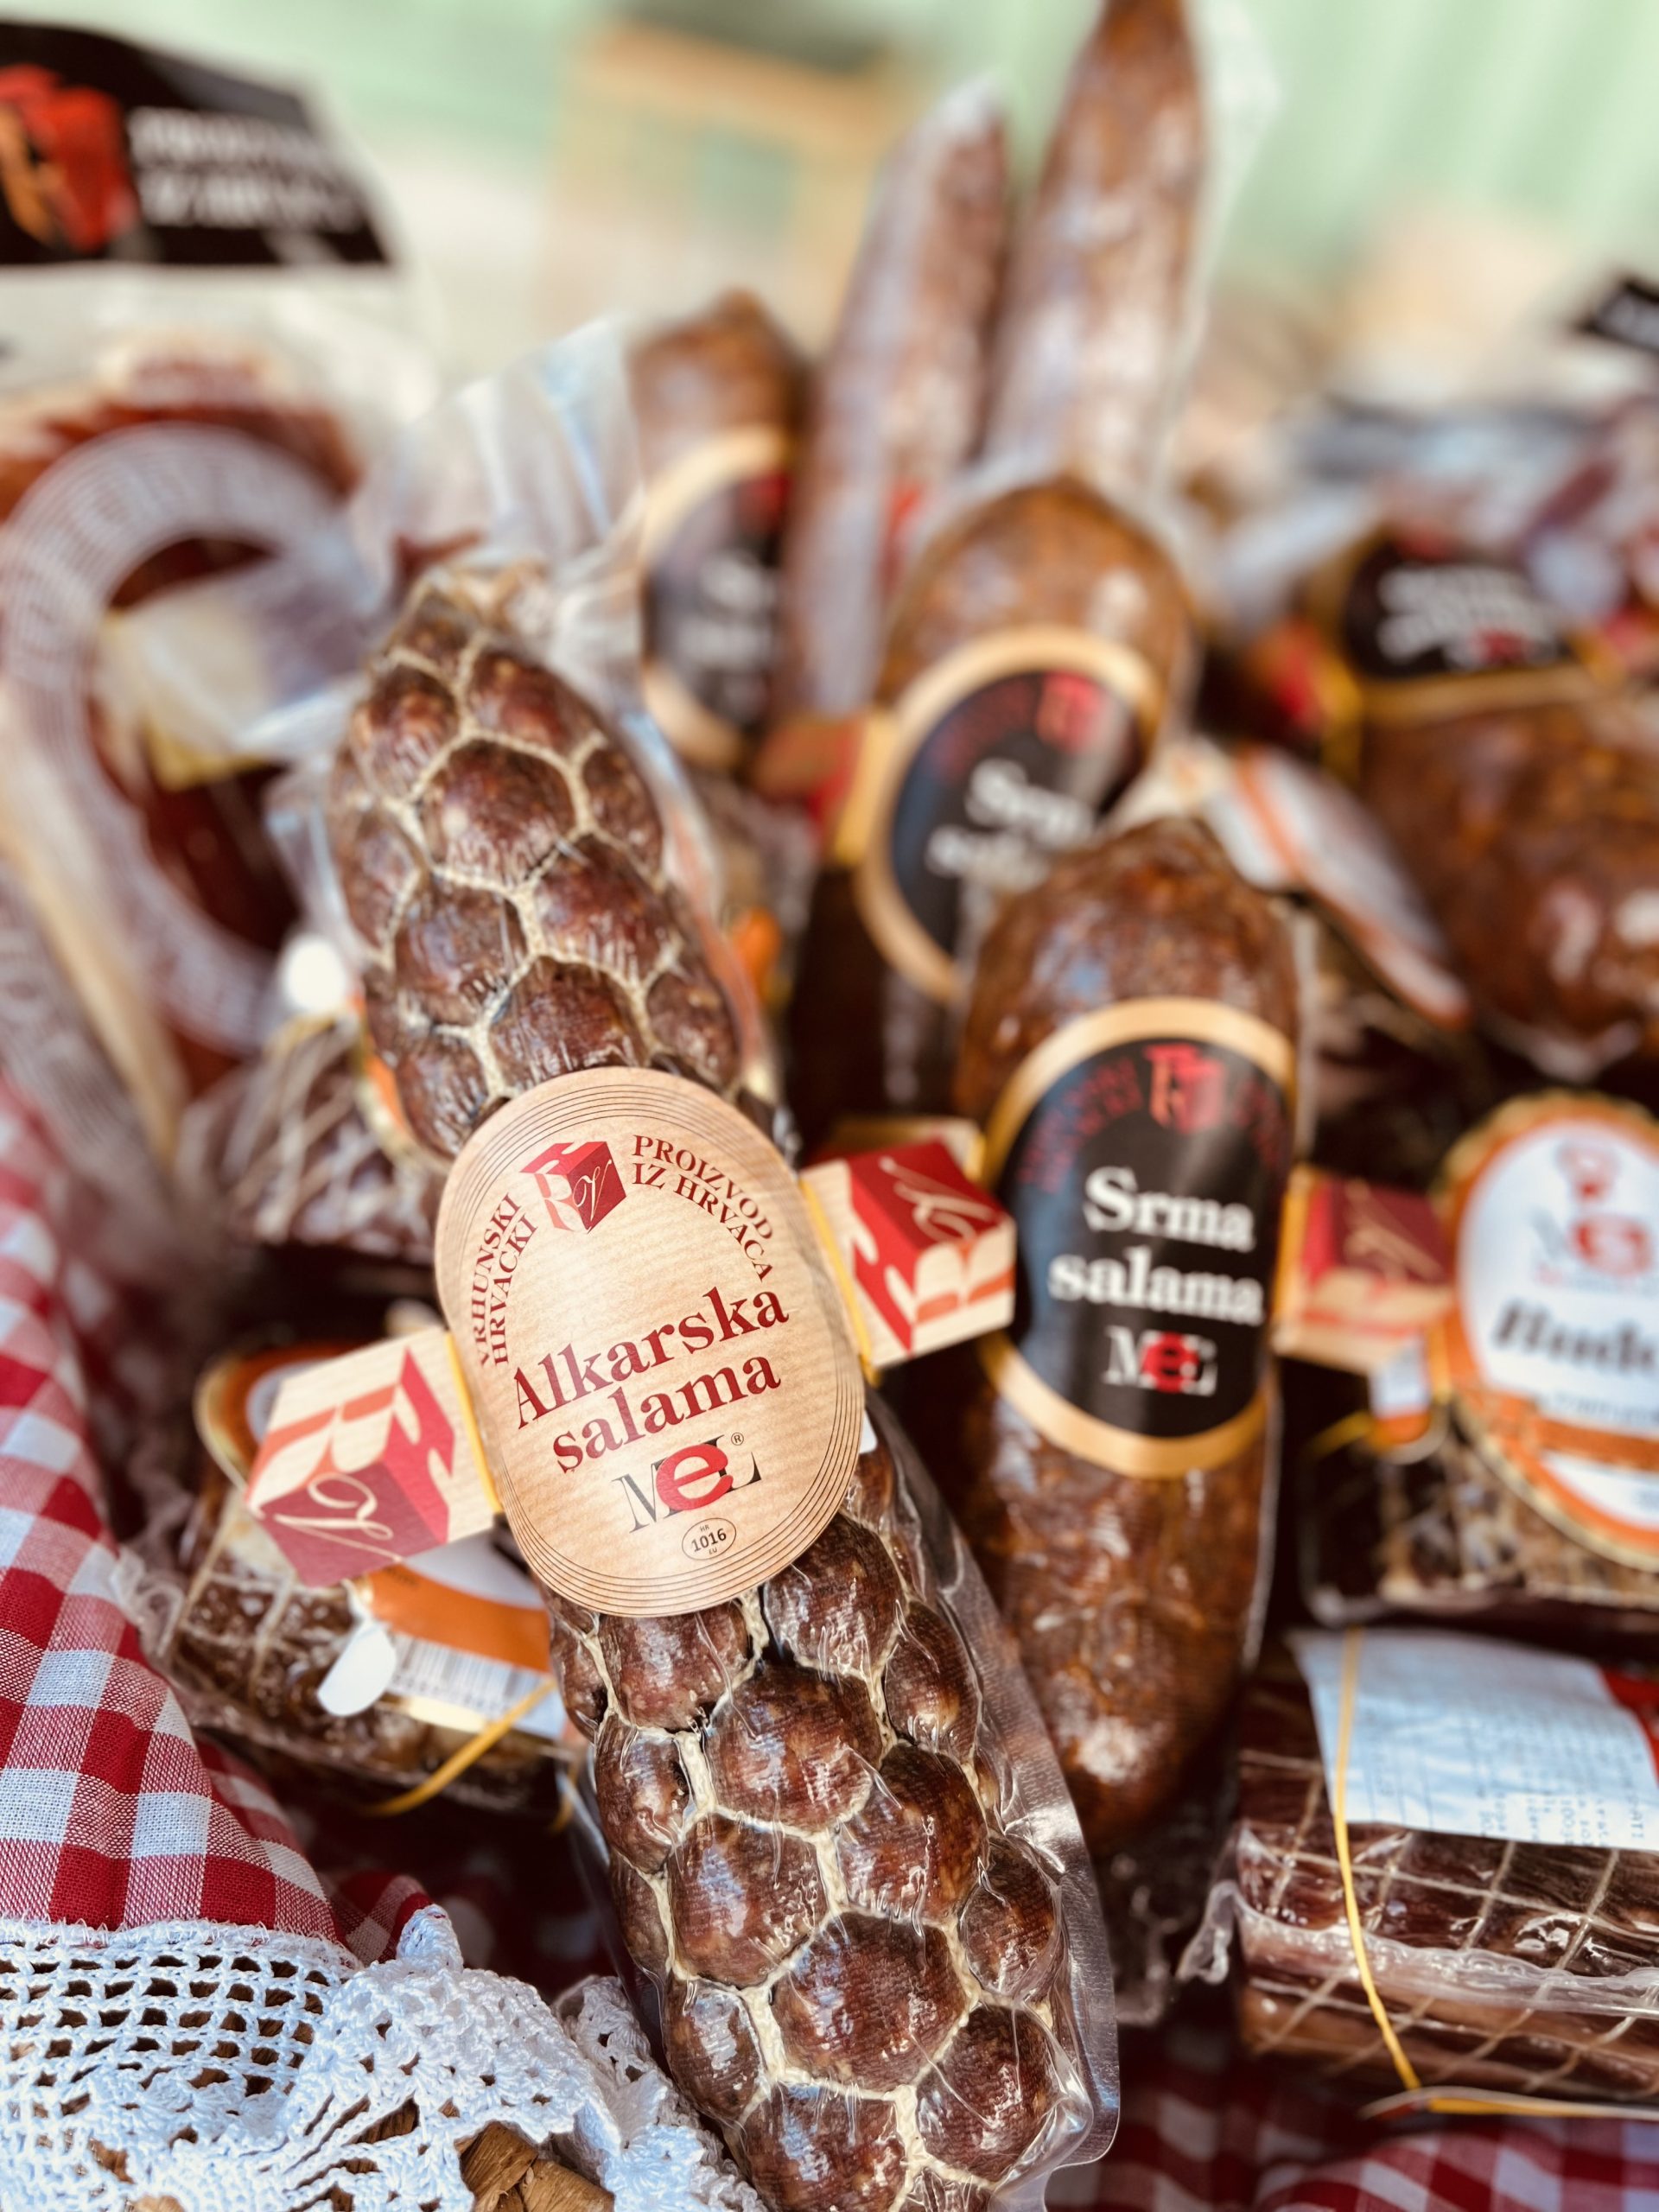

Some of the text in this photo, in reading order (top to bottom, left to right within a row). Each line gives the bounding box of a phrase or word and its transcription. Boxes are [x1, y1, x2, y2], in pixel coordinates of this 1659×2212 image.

[632, 1135, 773, 1240] PROIZVOD
[632, 1162, 774, 1282] IZ HRVACA
[472, 1192, 522, 1365] VRHUNSKI
[489, 1213, 539, 1366] HRVACKI
[1047, 1244, 1266, 1327] salama
[513, 1286, 790, 1429] Alkarska
[553, 1356, 782, 1474] salama
[690, 1528, 728, 1553] 1016
